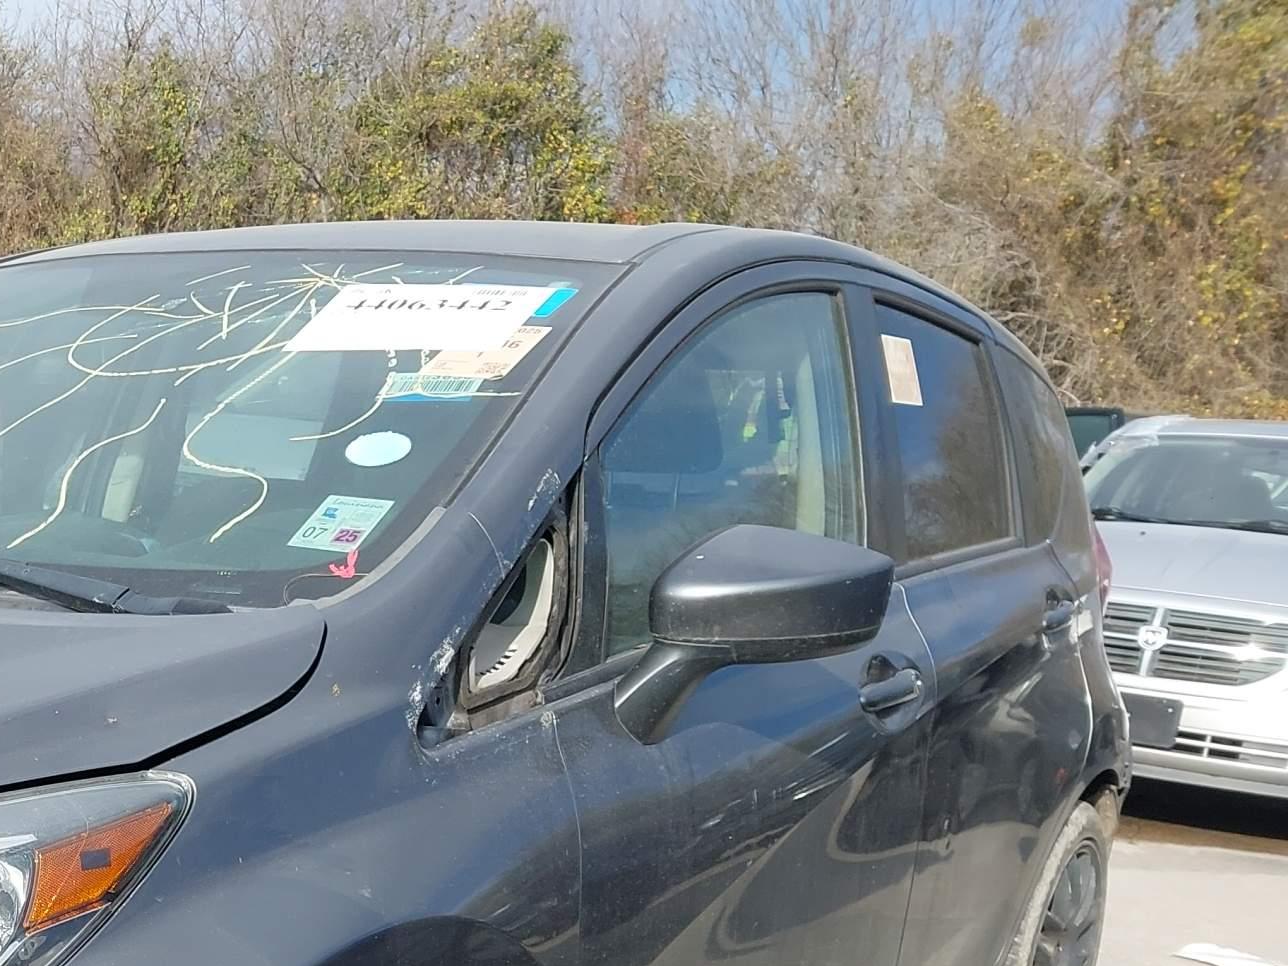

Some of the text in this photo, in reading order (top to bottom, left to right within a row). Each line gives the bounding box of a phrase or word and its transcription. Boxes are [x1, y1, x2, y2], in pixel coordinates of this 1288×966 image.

[346, 298, 513, 311] 44063442
[302, 526, 361, 543] 07 25
